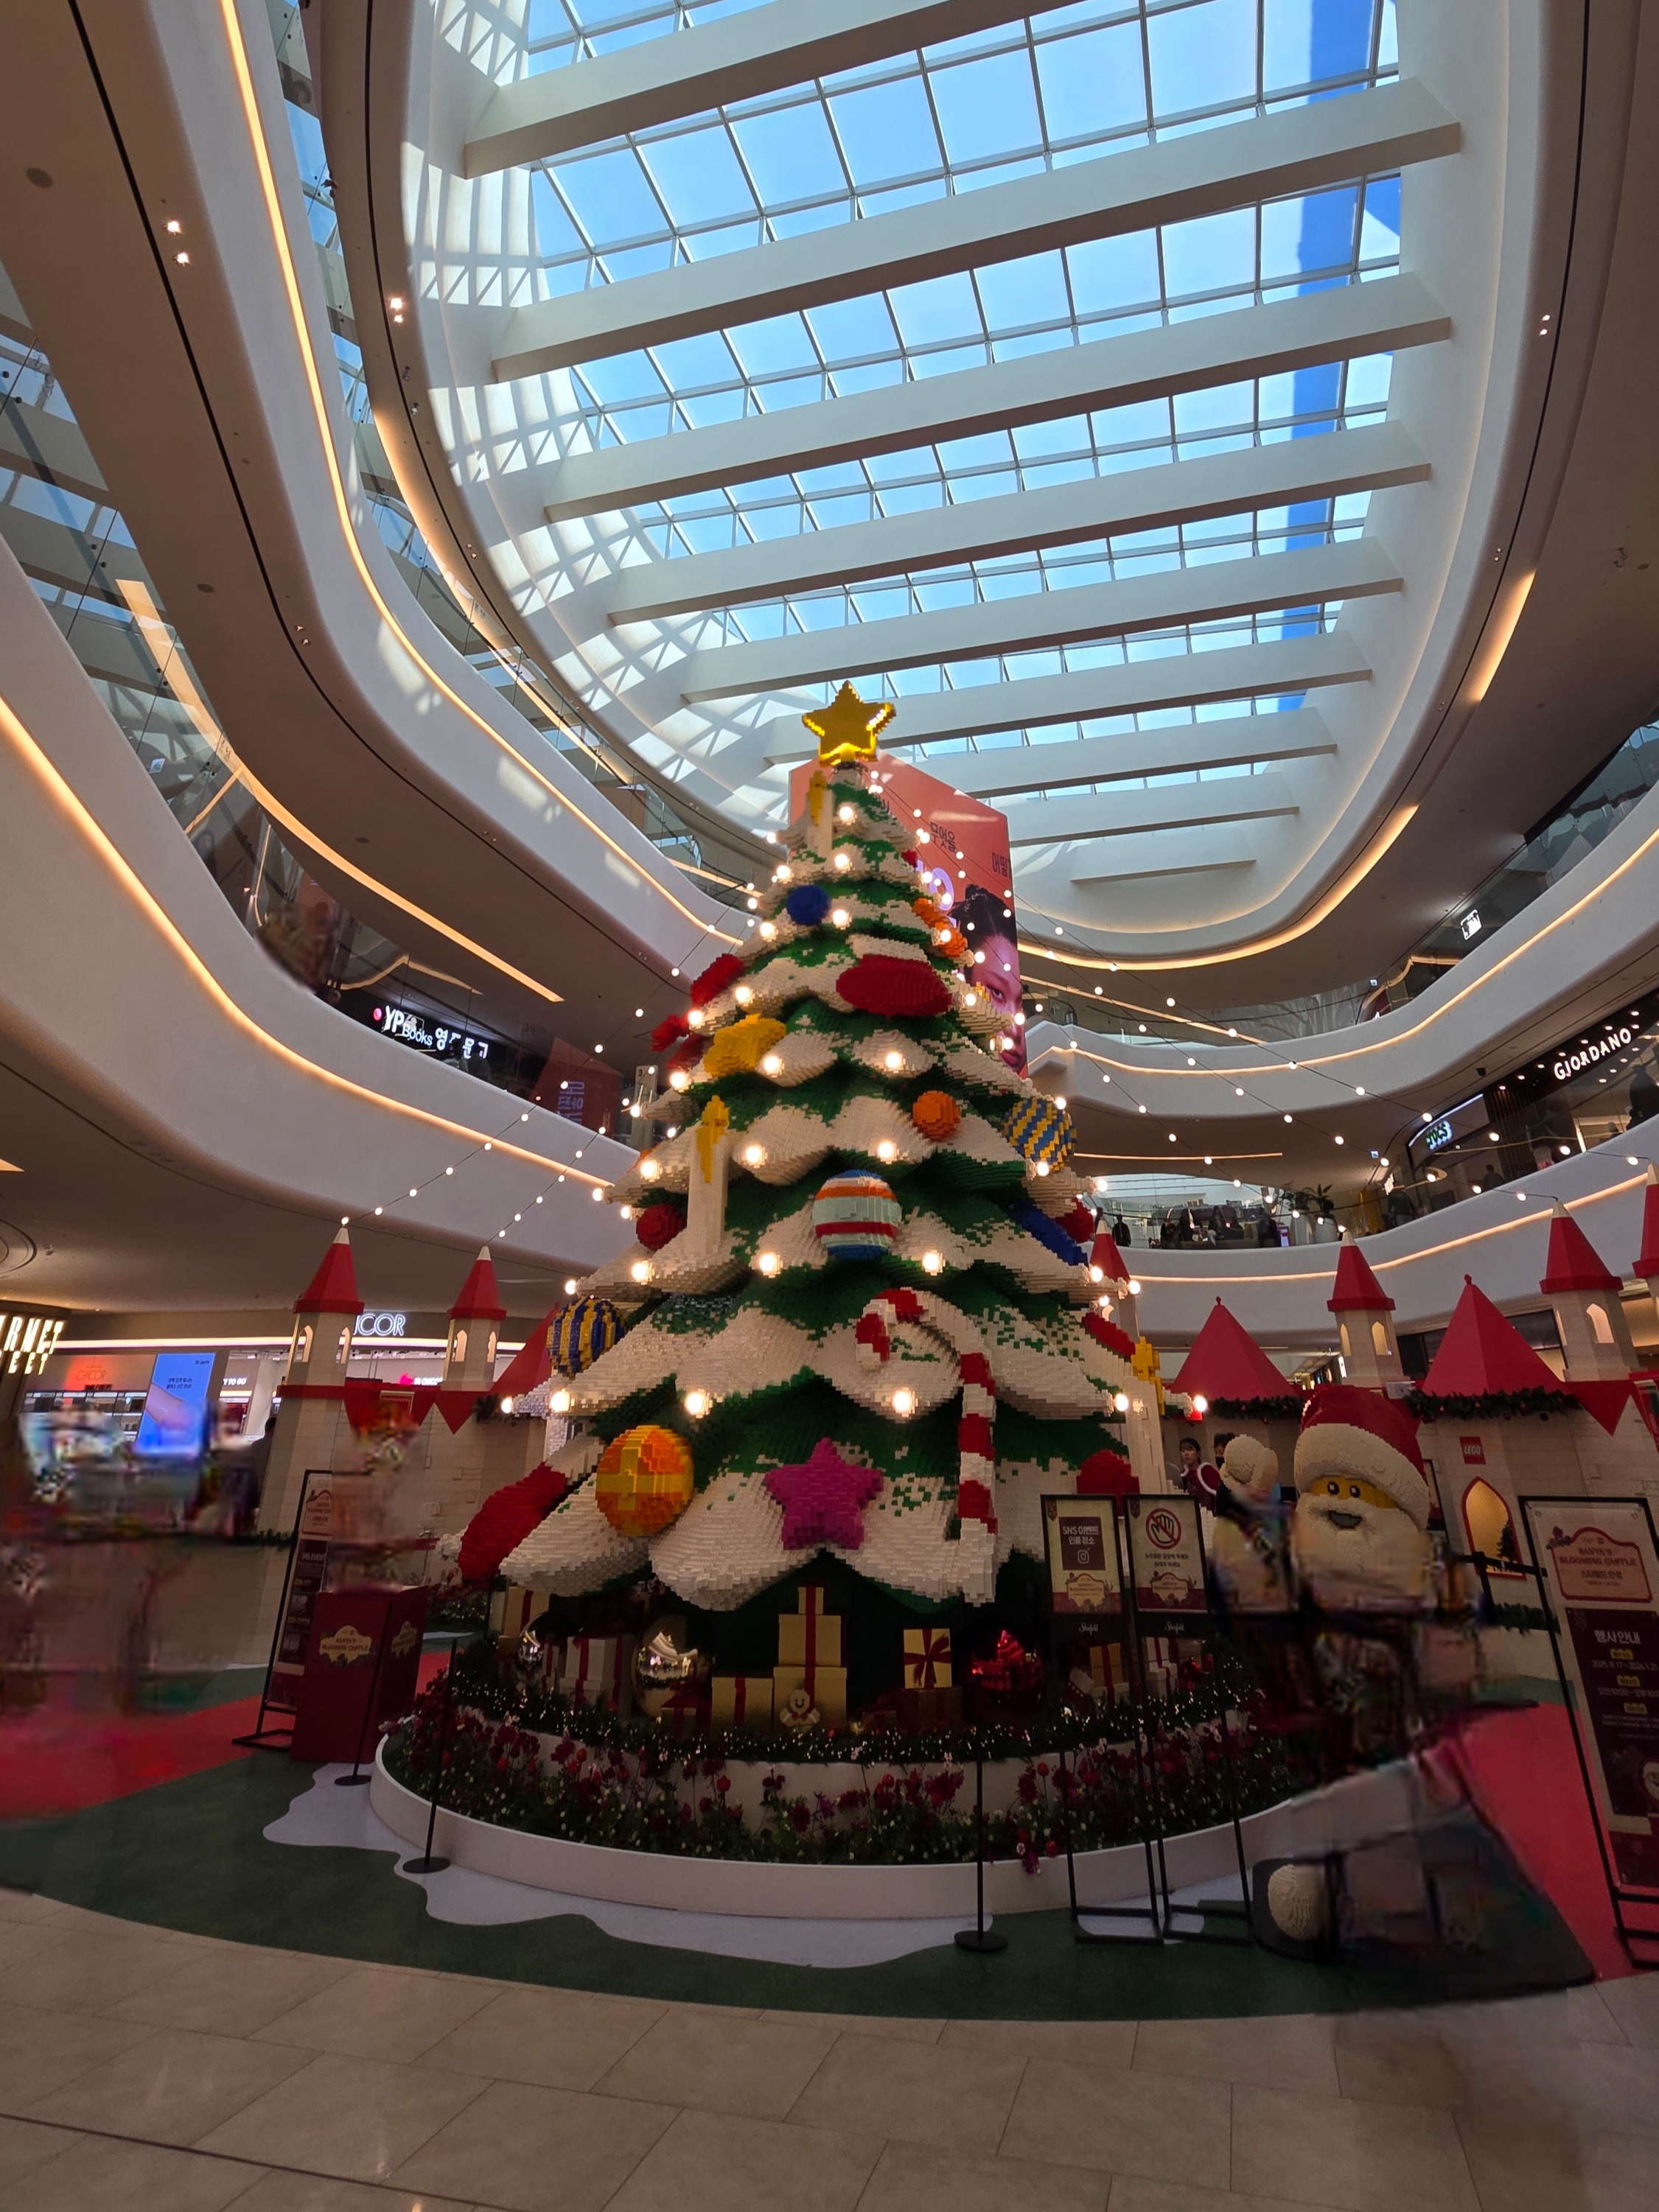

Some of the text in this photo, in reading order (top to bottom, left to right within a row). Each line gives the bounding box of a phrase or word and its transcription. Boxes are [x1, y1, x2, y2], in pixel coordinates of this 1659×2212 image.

[930, 822, 957, 853] 무엇을
[383, 1005, 405, 1033] YP
[402, 1023, 433, 1046] Books
[1554, 1028, 1632, 1080] GIORDANO
[0, 1349, 49, 1375] EET
[77, 1370, 106, 1381] CHICOR
[1464, 1446, 1481, 1455] LEGO
[1063, 1525, 1100, 1535] SNS 이벤트
[1082, 1536, 1095, 1545] 장소
[1560, 1556, 1602, 1565] BLOOMING
